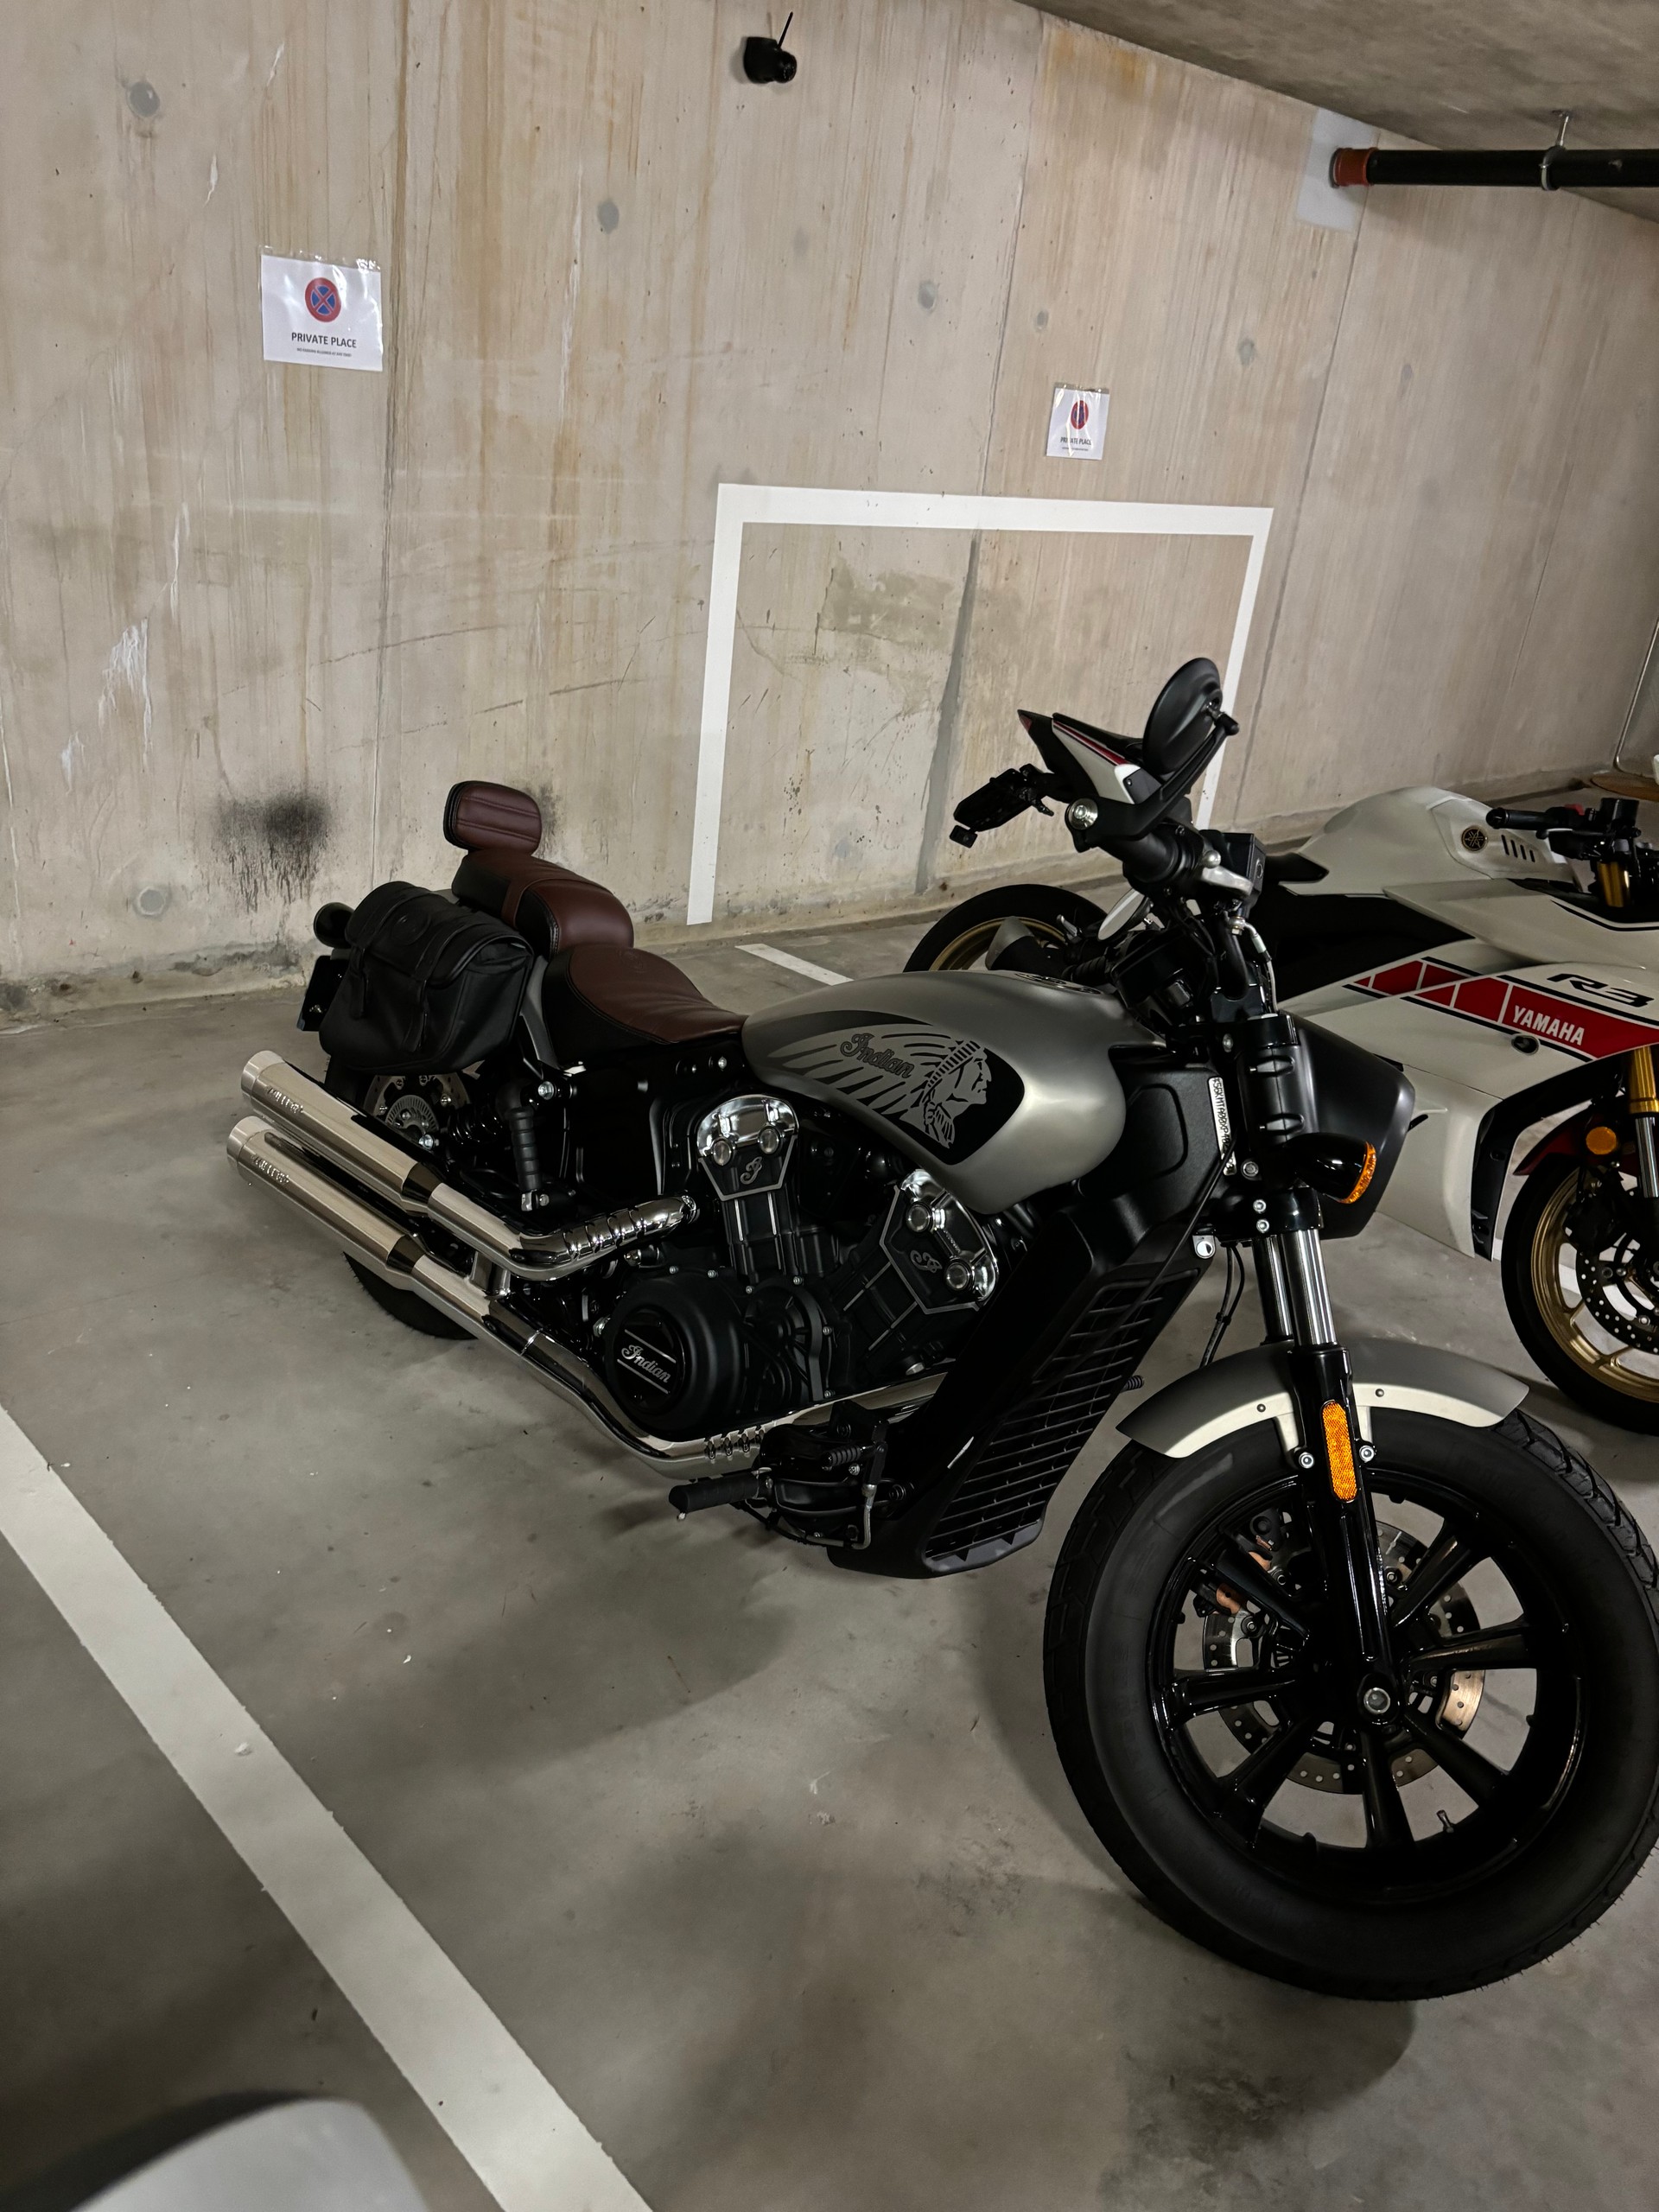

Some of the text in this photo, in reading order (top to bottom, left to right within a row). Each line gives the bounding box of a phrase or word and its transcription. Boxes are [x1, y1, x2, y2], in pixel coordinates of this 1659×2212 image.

[291, 332, 357, 348] PRIVATE PLACE
[1547, 973, 1655, 1007] R3
[1513, 1005, 1585, 1046] YAMAHA
[840, 1033, 914, 1078] Indian
[621, 1344, 671, 1382] Indian
